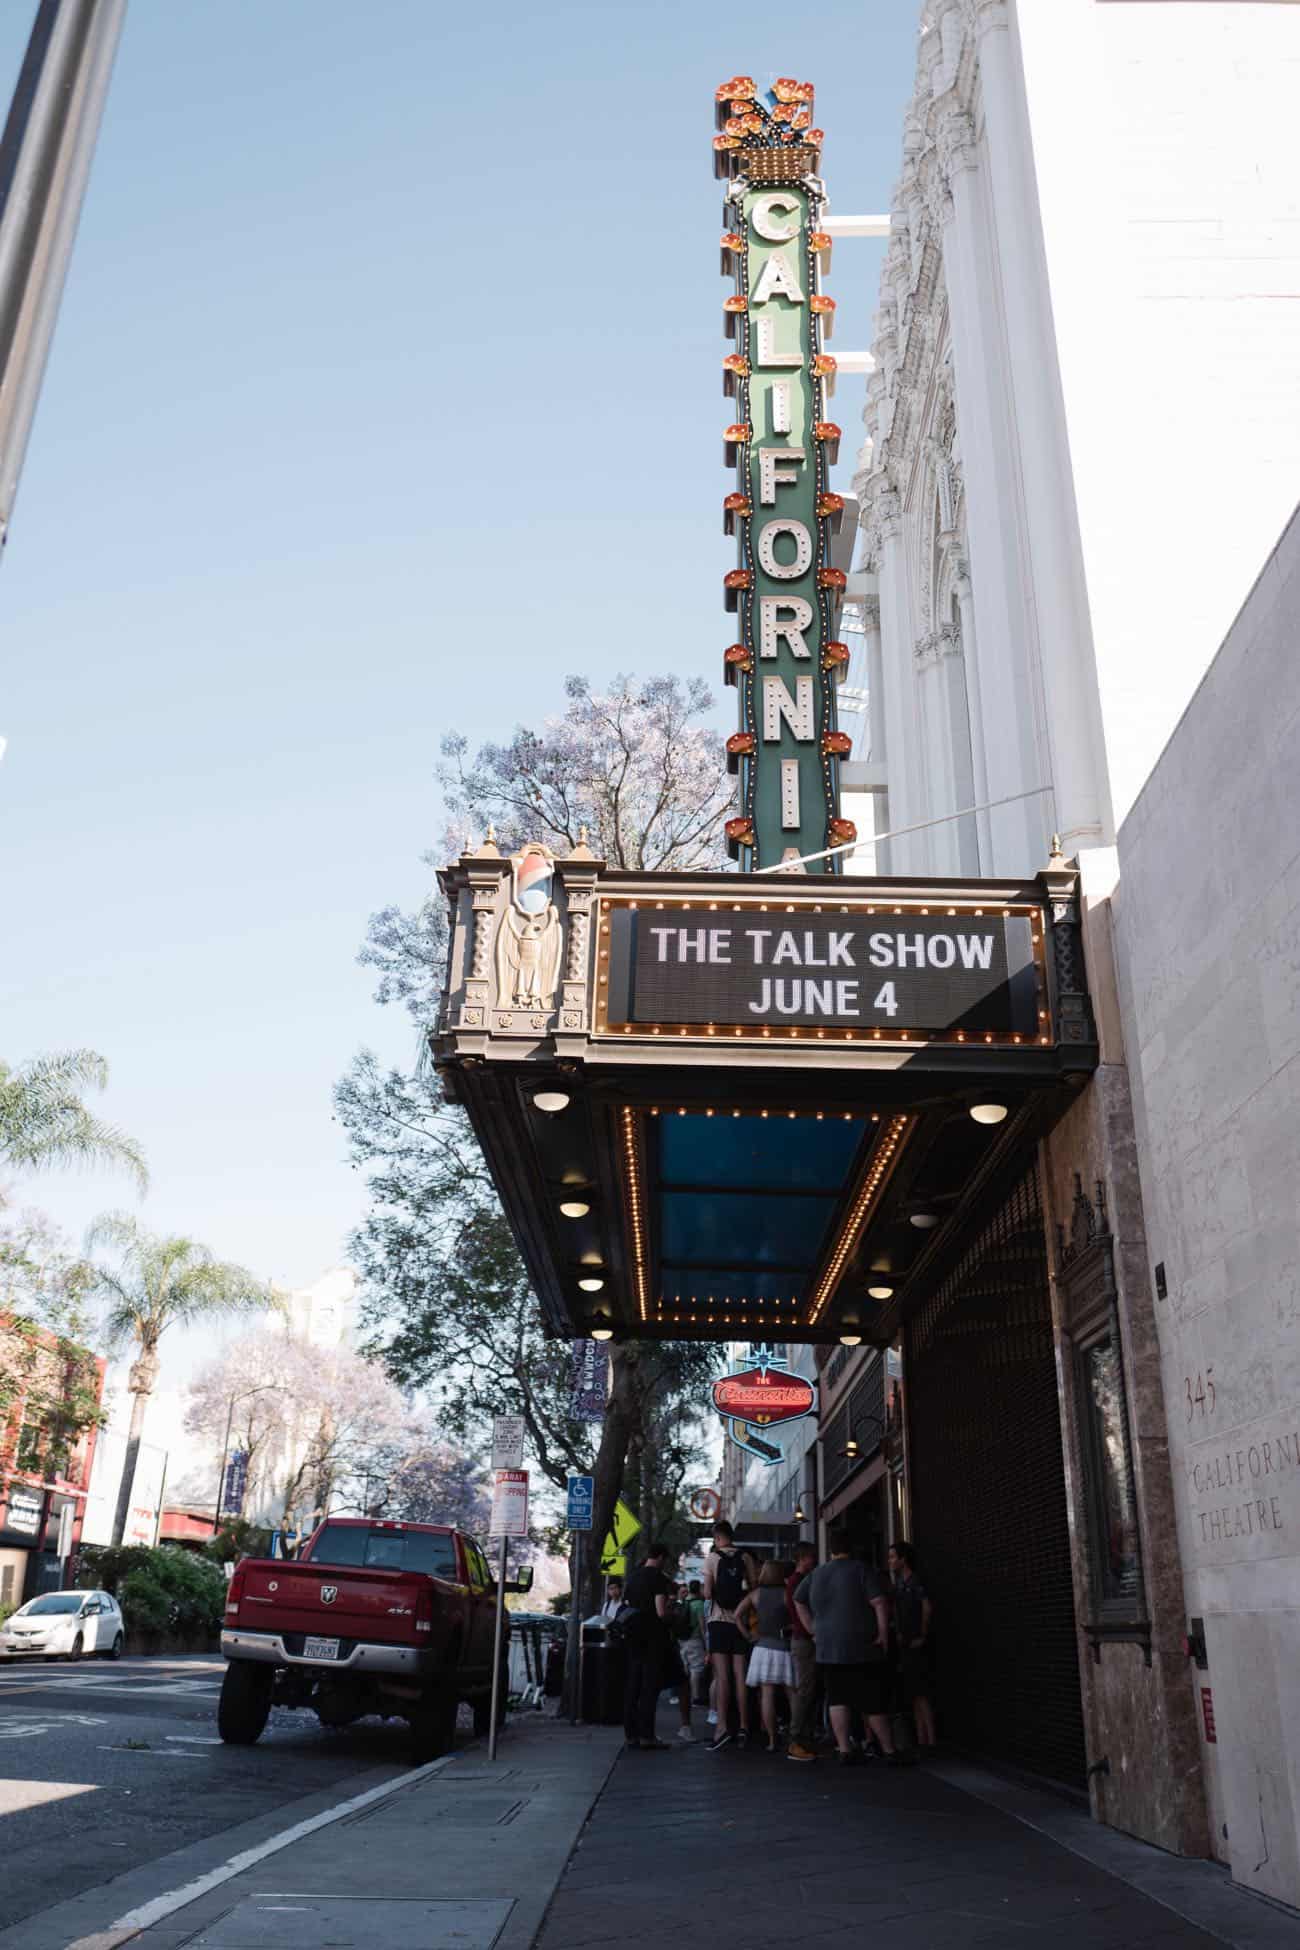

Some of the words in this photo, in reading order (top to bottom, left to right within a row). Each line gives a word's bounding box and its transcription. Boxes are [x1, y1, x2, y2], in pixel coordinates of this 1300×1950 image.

[650, 927, 732, 964] THE
[745, 930, 856, 967] TALK
[869, 932, 994, 969] SHOW
[749, 978, 859, 1016] JUNE
[873, 981, 898, 1017] 4
[1184, 1368, 1216, 1424] 345
[1198, 1496, 1283, 1542] THEATRE
